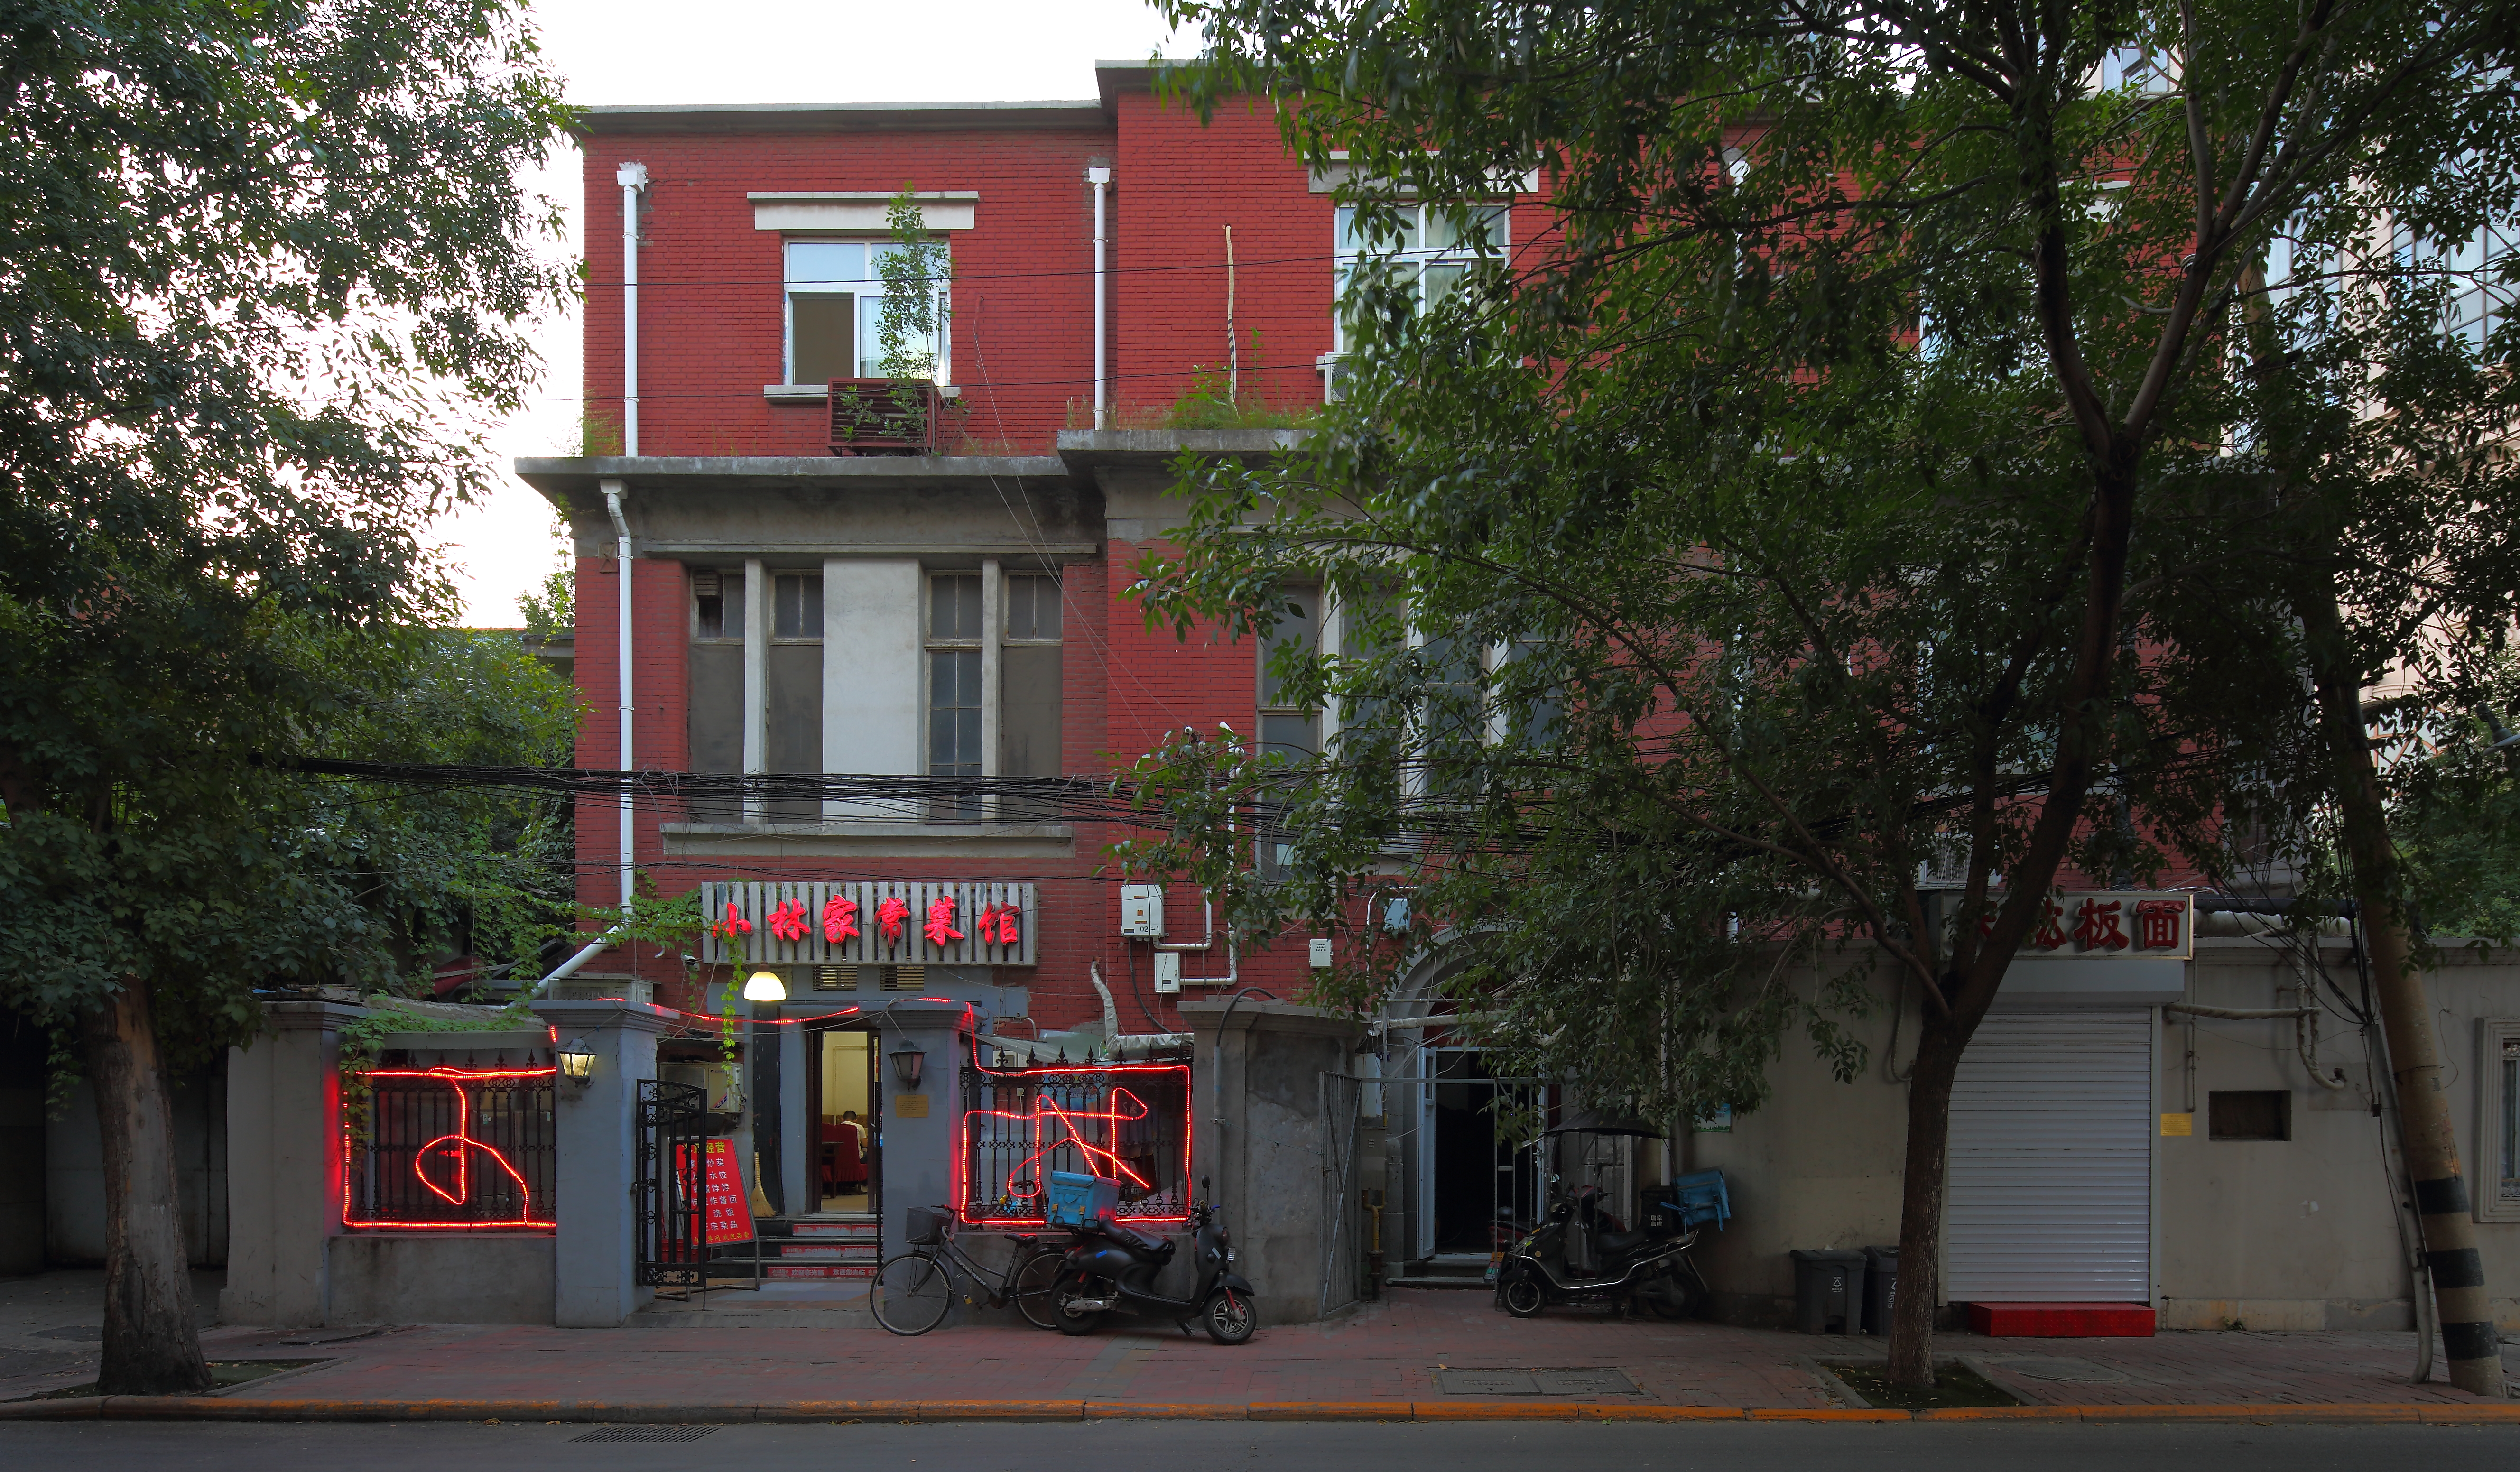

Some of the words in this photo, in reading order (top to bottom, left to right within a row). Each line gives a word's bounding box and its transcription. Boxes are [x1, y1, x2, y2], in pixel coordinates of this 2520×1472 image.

[712, 895, 1021, 948] 小林家常菜馆
[690, 1158, 725, 1168] 家炒菜
[691, 1195, 737, 1207] 传炸酱面
